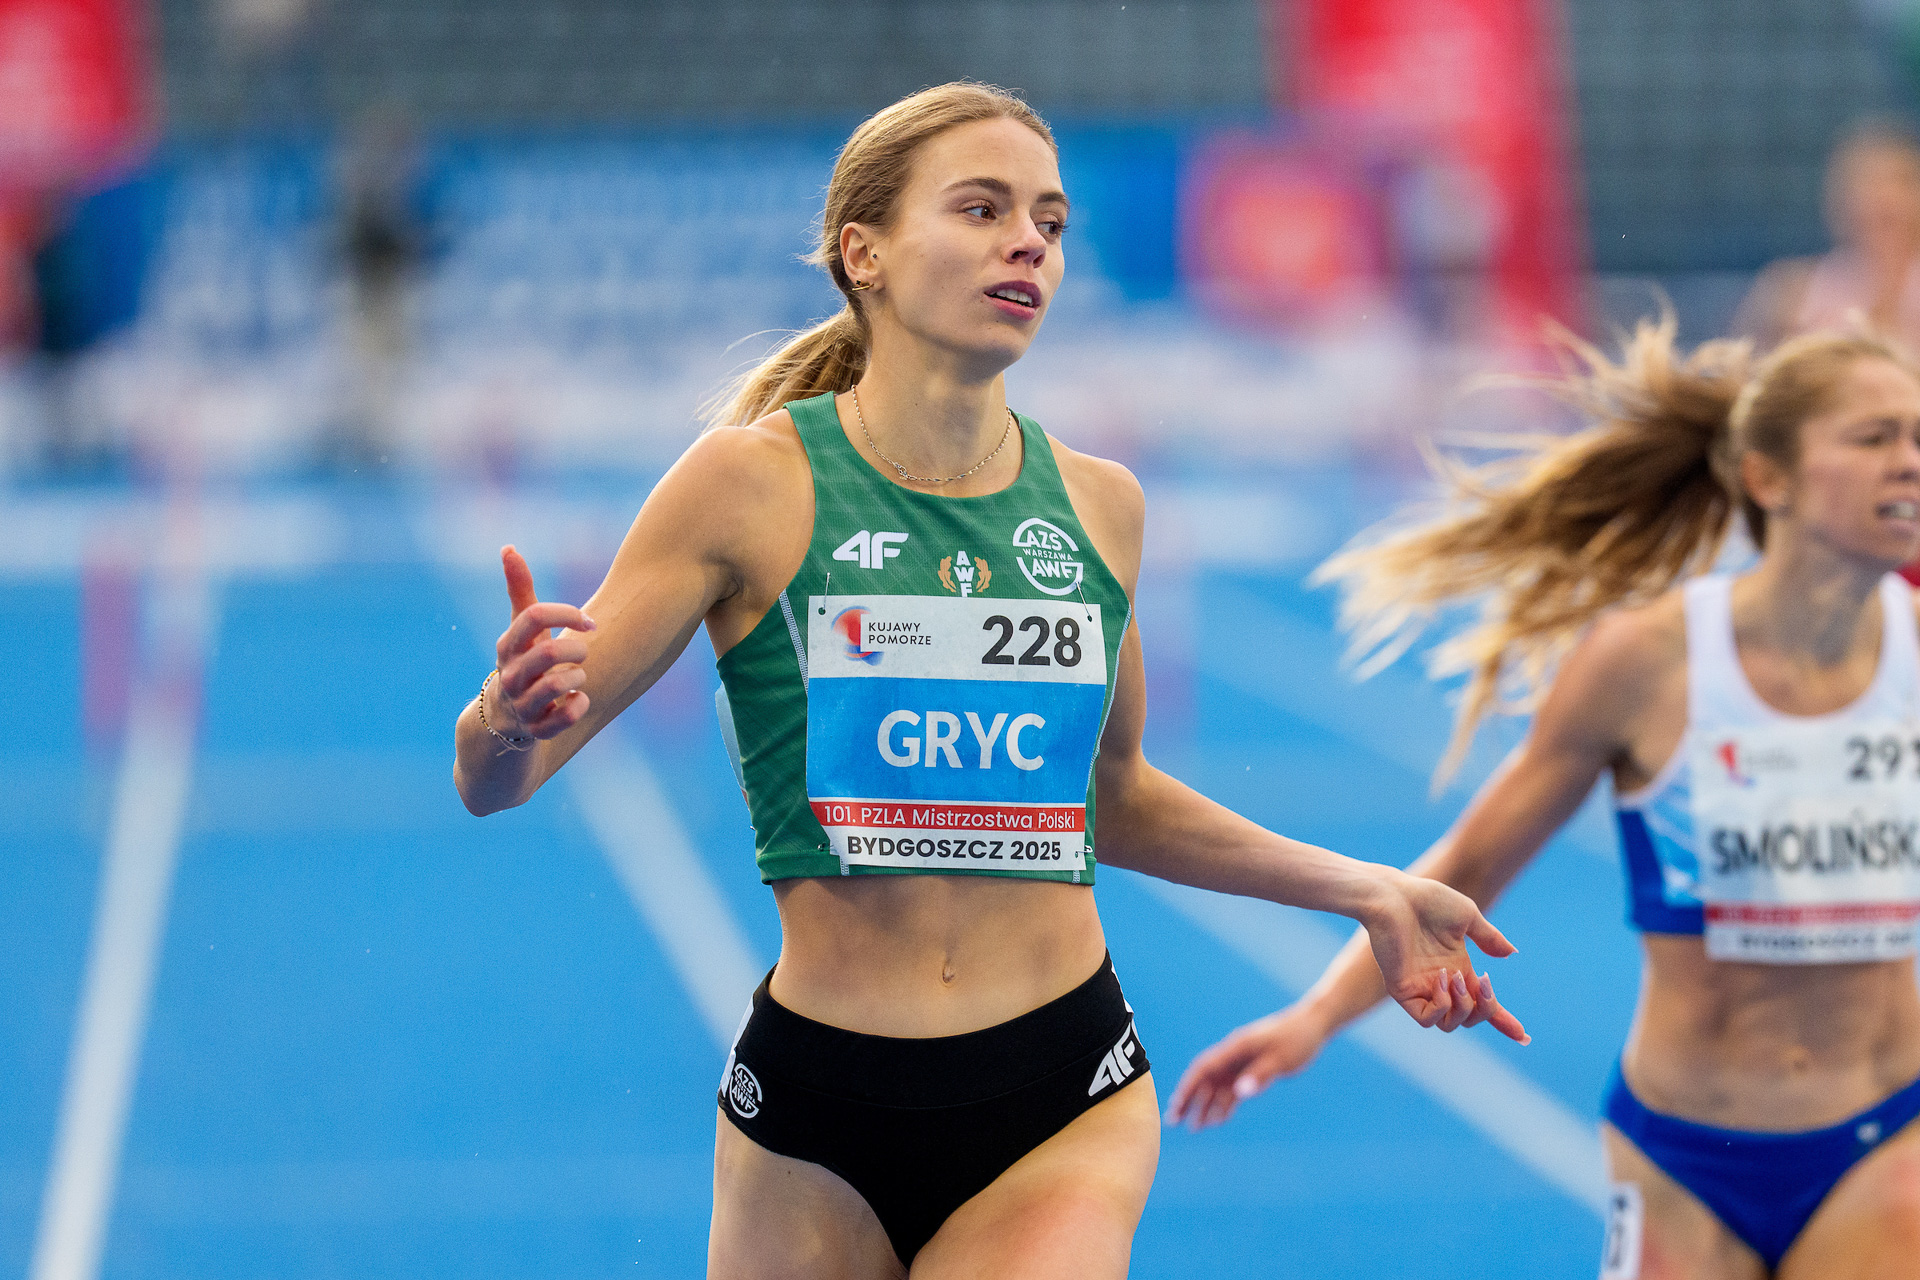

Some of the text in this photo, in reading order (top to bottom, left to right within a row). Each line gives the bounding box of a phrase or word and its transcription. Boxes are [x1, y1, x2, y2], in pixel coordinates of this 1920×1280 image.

[832, 529, 910, 570] 4F
[1025, 529, 1063, 551] AZS
[1022, 547, 1074, 562] WARSZAWA
[1031, 557, 1080, 579] AWF
[868, 622, 921, 633] KUJAWY
[868, 634, 932, 646] POMORZE
[981, 614, 1082, 668] 228
[876, 709, 1047, 771] GRYC
[824, 805, 1075, 829] 101. PZLA Mistrzostwa Polski
[847, 835, 1061, 861] BYDGOSZCZ 2025
[737, 1069, 755, 1095] AZS
